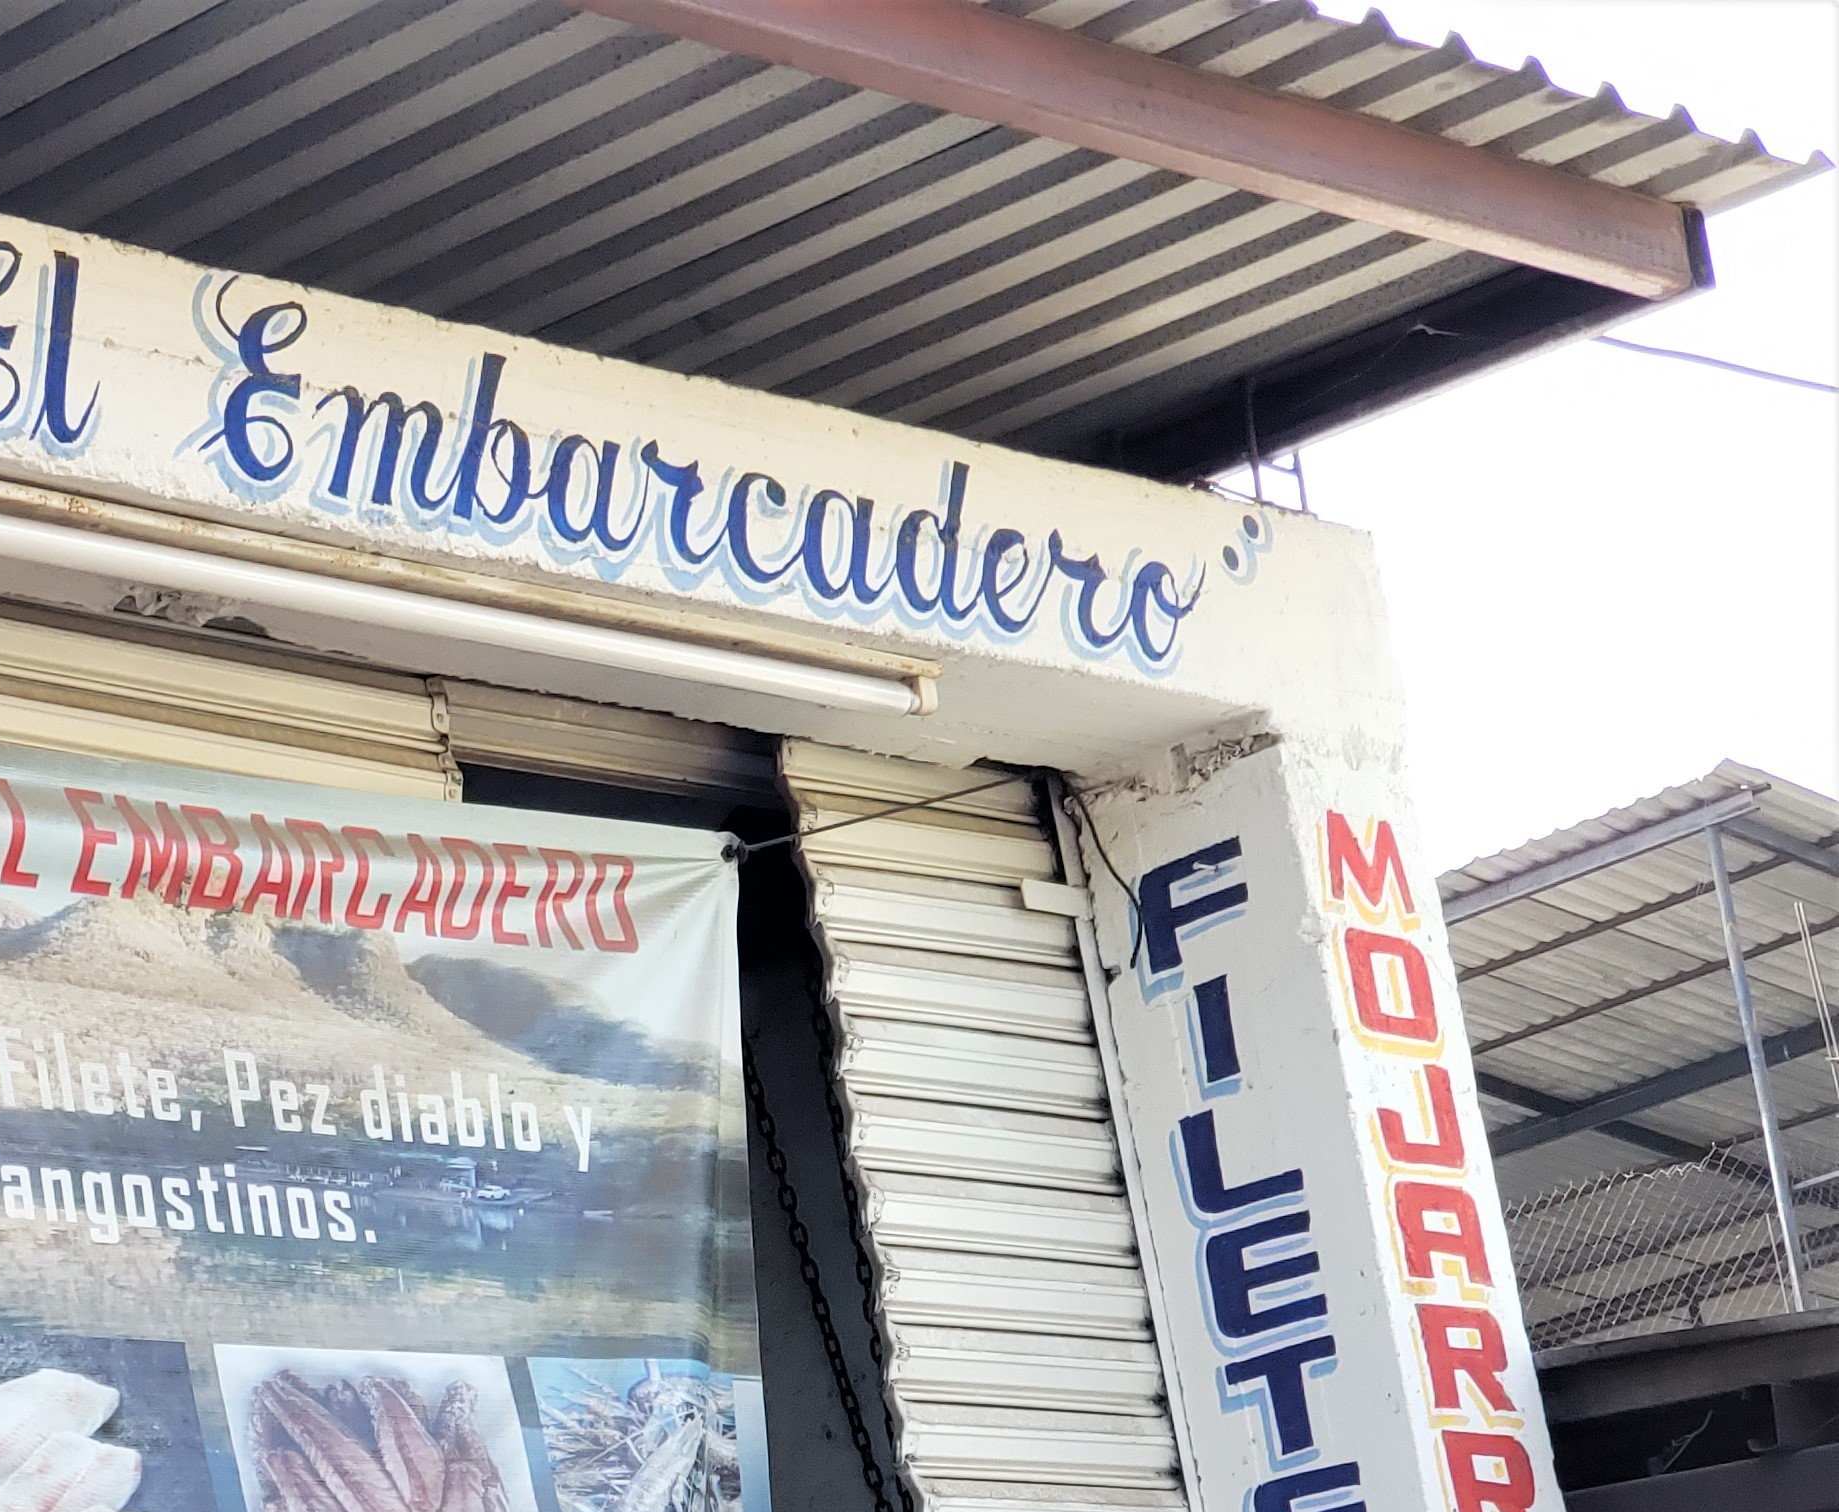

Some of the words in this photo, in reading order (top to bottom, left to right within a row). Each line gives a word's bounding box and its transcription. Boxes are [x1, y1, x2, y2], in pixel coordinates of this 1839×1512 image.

[197, 264, 1207, 662] Embarcadero
[68, 787, 642, 956] EMBARCADERO
[222, 1047, 330, 1136] Pez
[358, 1066, 543, 1155] diablo
[563, 1098, 597, 1174] y
